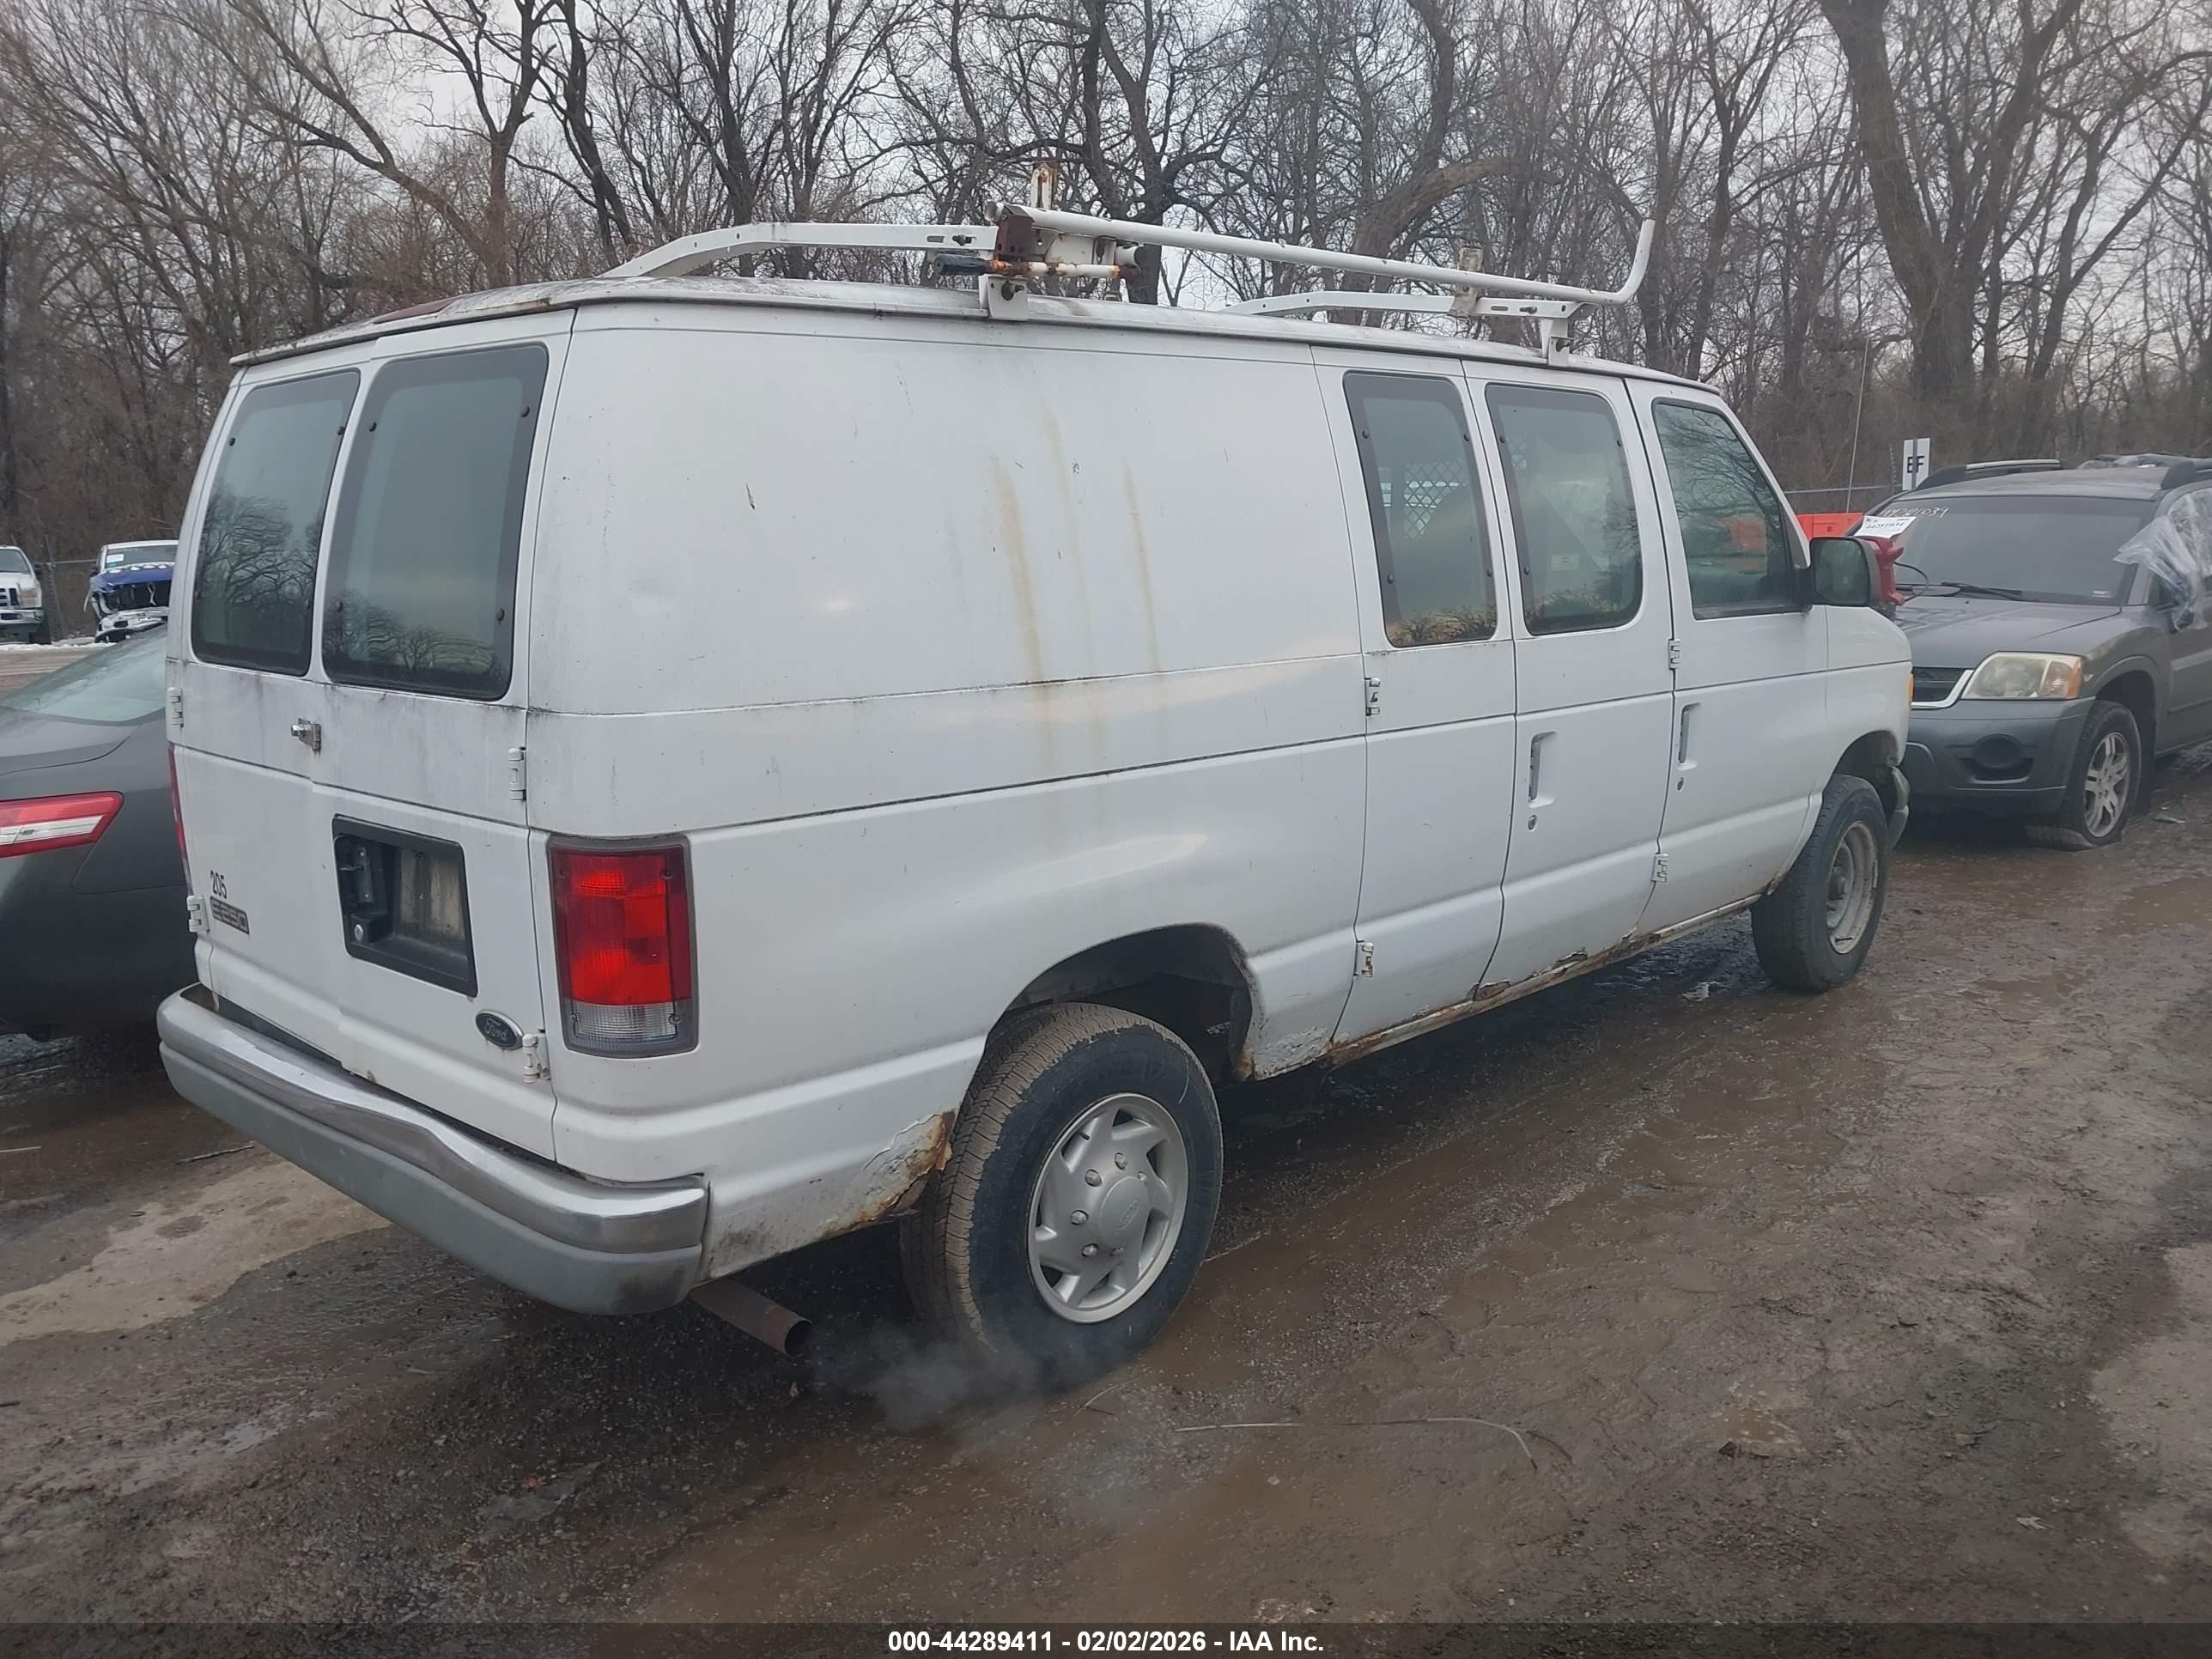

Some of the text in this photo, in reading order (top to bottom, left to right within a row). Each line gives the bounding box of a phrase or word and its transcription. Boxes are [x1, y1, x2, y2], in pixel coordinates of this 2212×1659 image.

[1907, 455, 1925, 473] EF
[210, 869, 228, 900] 205
[483, 1018, 508, 1042] Ford
